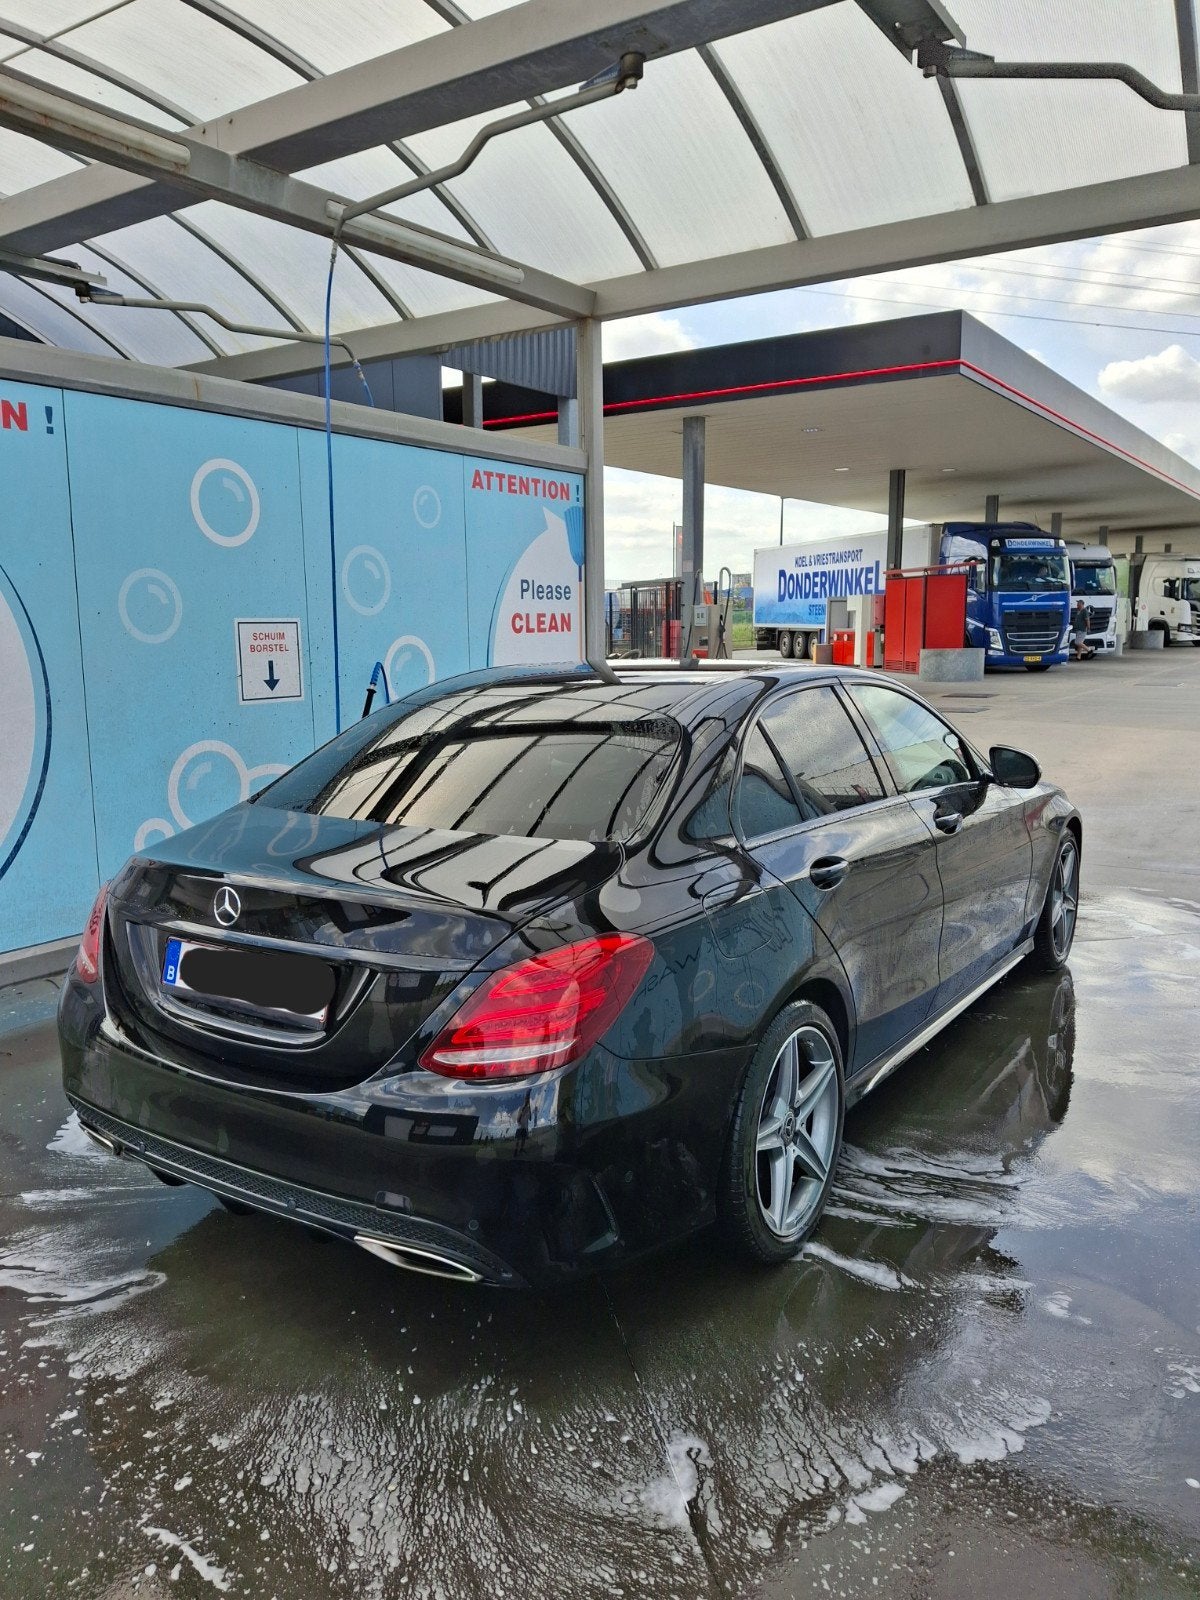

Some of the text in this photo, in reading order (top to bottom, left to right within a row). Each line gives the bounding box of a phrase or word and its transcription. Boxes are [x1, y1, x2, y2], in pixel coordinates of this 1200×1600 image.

[471, 469, 570, 501] ATTENTION
[813, 548, 863, 566] VRIESTRANSPORT
[520, 579, 572, 601] Please
[778, 560, 885, 602] DONDERWINKEL
[511, 612, 572, 634] CLEAN
[252, 632, 286, 641] SCHUIM
[250, 643, 290, 653] BORSTEL
[166, 965, 175, 980] B
